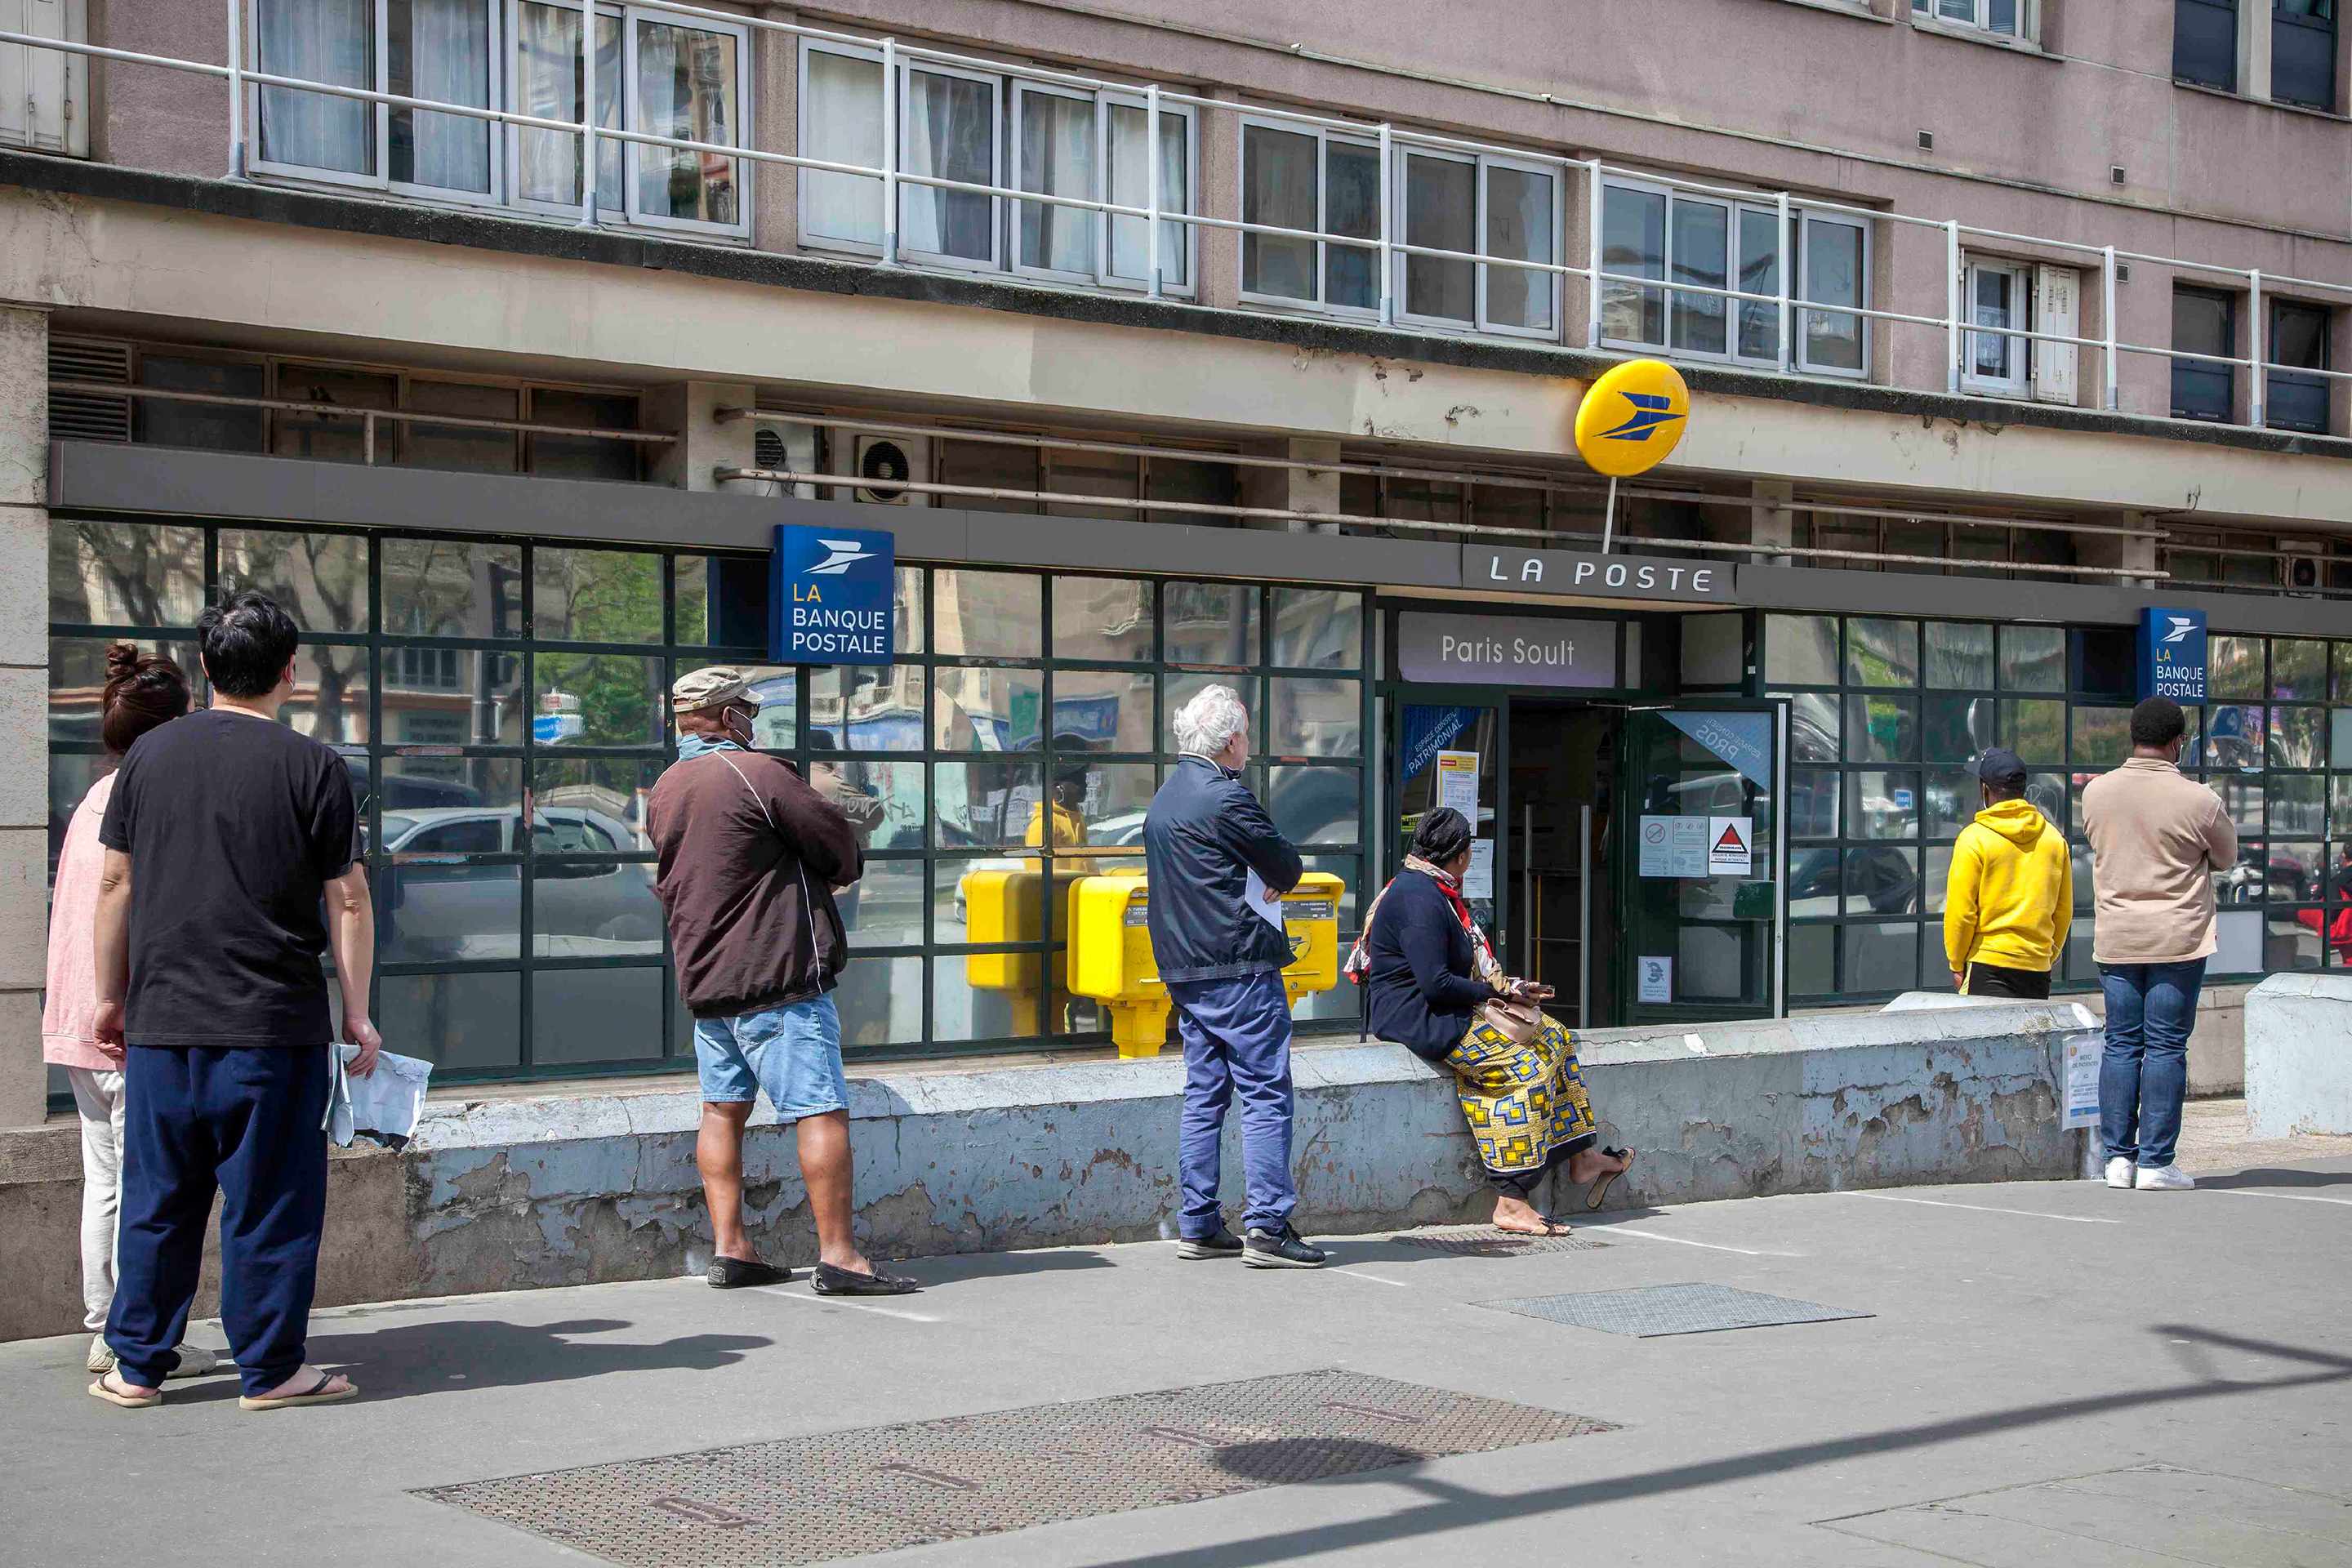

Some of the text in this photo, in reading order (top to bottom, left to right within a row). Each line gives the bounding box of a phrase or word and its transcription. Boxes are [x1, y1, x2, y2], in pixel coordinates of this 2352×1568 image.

[1490, 555, 1713, 592] LA POSTE
[793, 583, 822, 603] LA
[793, 608, 885, 631] BANQUE
[793, 632, 885, 654] POSTALE
[1442, 635, 1575, 666] Paris Soult
[2156, 648, 2172, 662] LA
[2156, 666, 2203, 682] BANQUE
[2157, 683, 2203, 697] POSTALE
[1414, 710, 1458, 753] ESPACE CONSEIL
[1408, 719, 1463, 774] PATRIMONIAL
